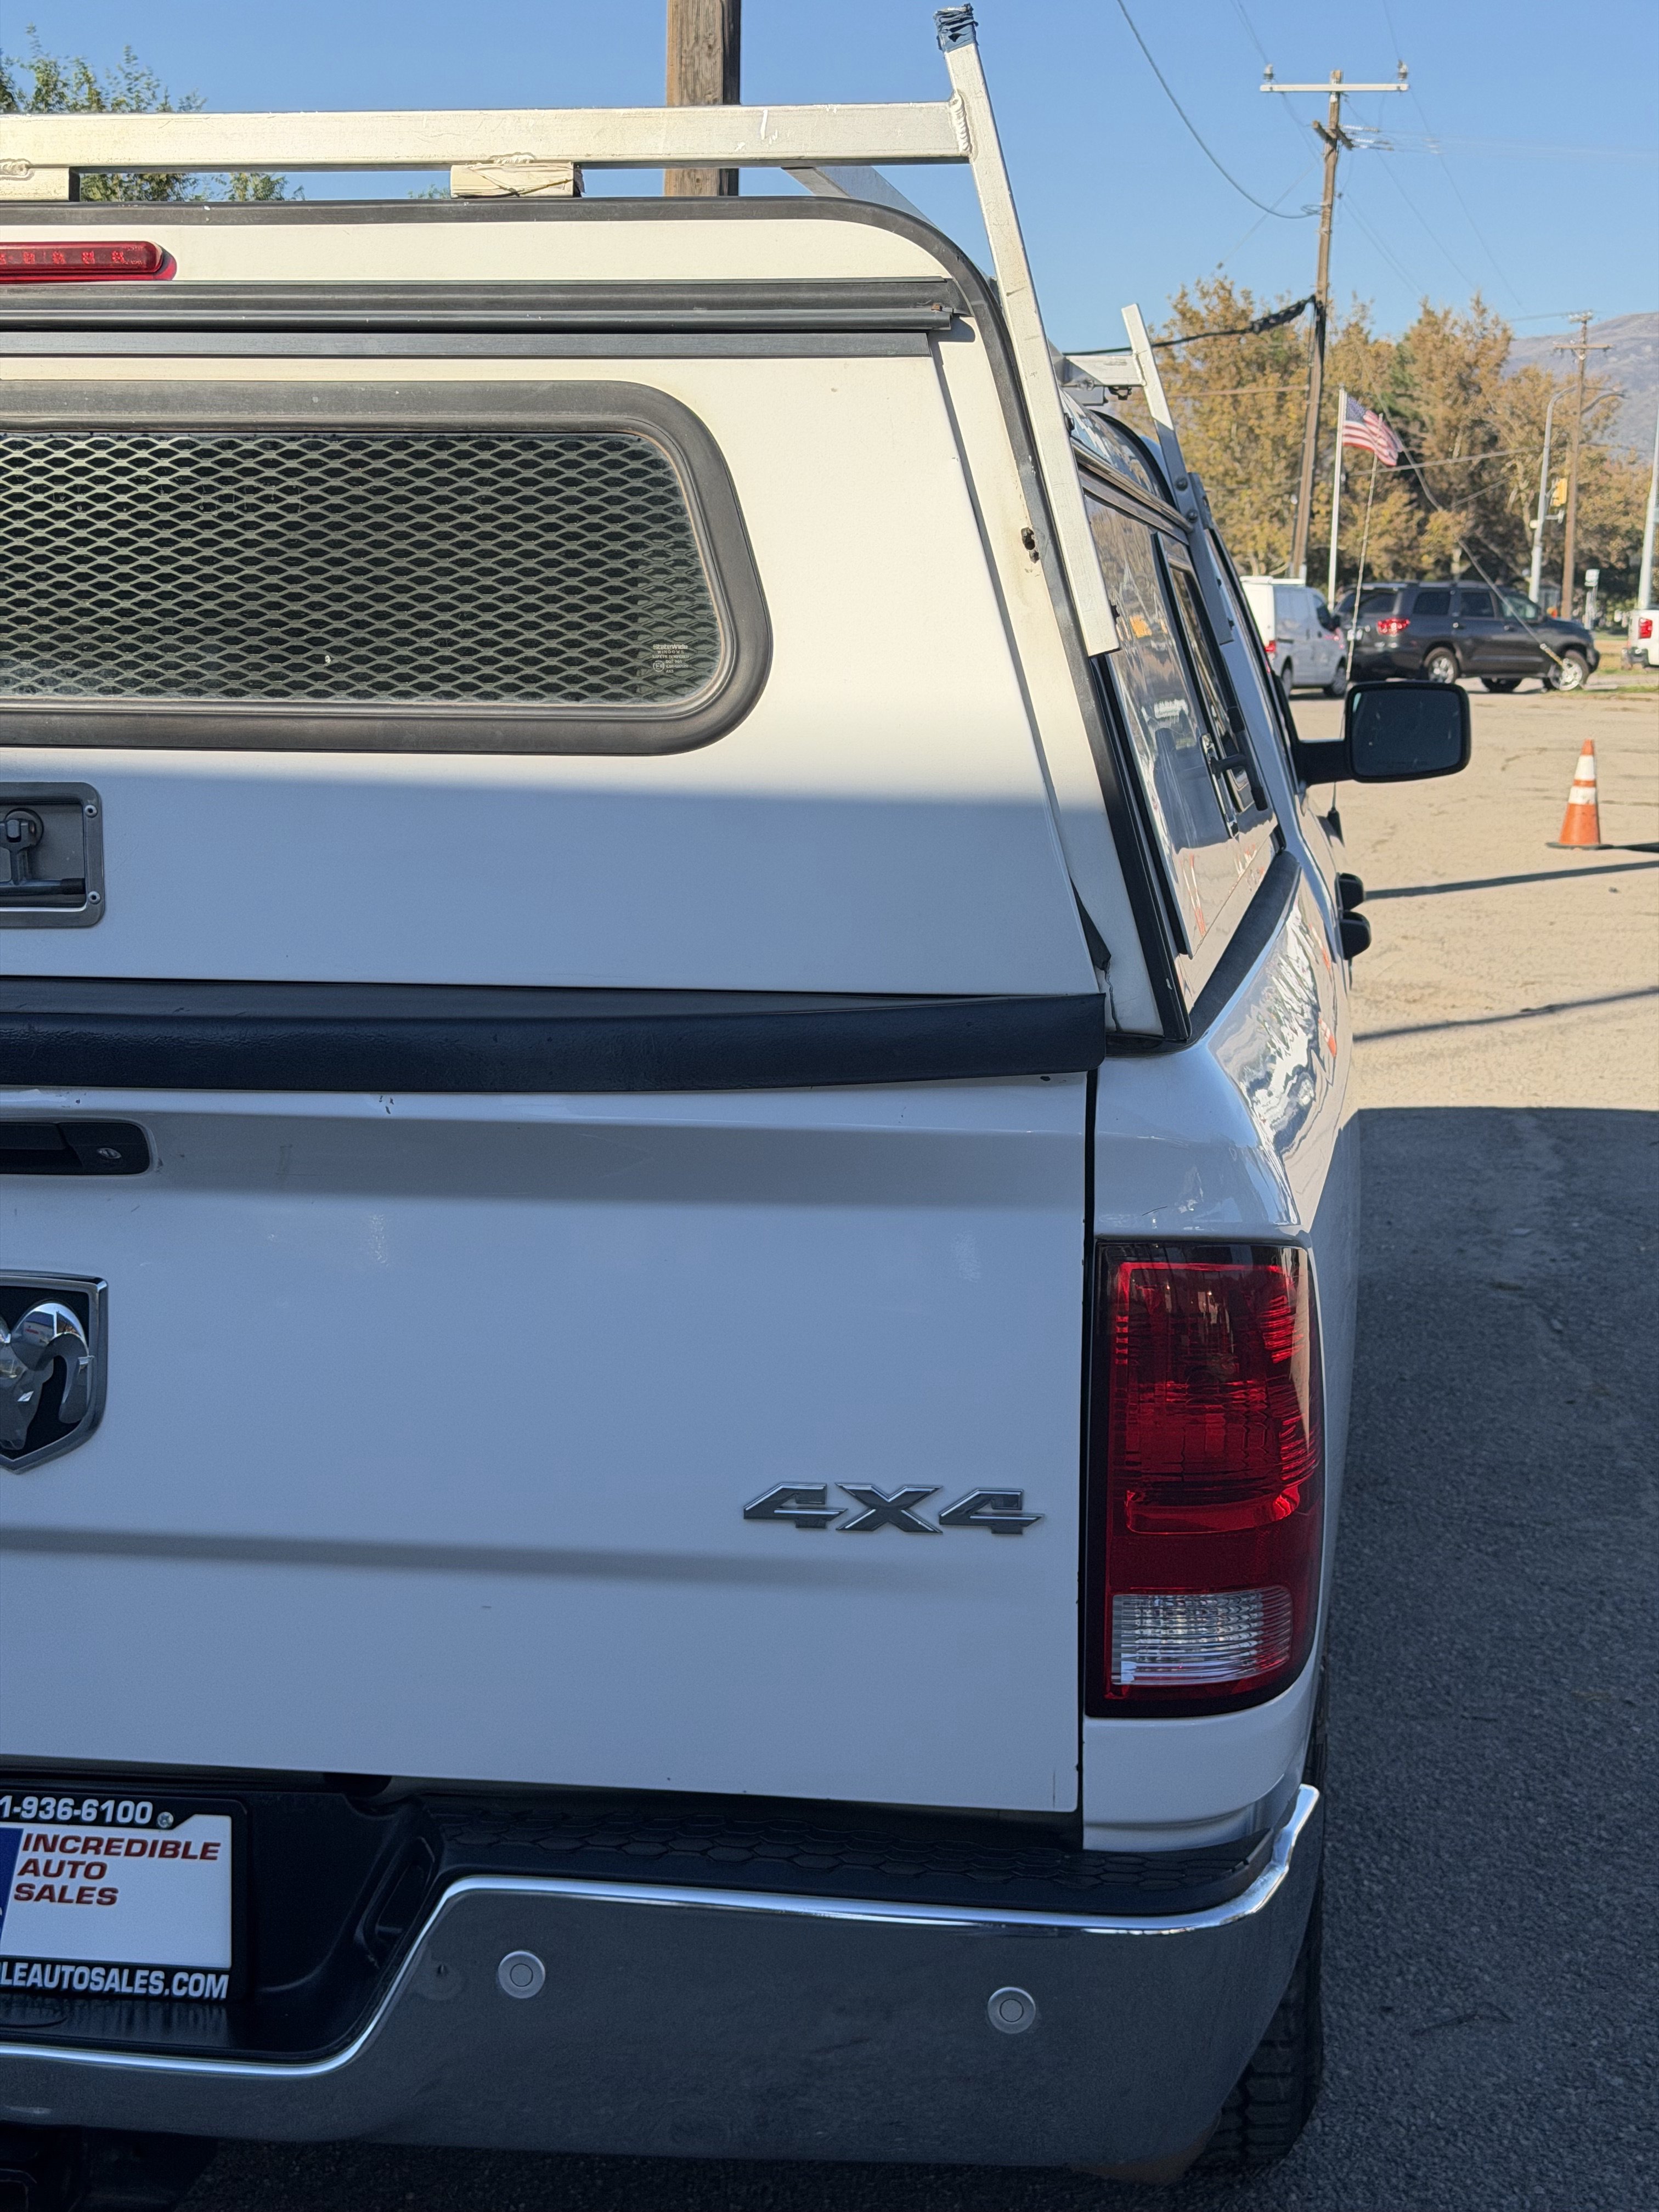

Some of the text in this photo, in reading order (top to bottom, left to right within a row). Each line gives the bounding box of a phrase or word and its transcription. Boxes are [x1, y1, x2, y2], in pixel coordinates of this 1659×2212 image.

[743, 1482, 1045, 1535] 4X4
[0, 1795, 153, 1824] 1-936-6100
[22, 1833, 221, 1860] INCREDIBLE
[17, 1858, 108, 1880] AUTO
[14, 1883, 119, 1905] SALES
[0, 1961, 229, 1999] LEAUTOSALES.COM
